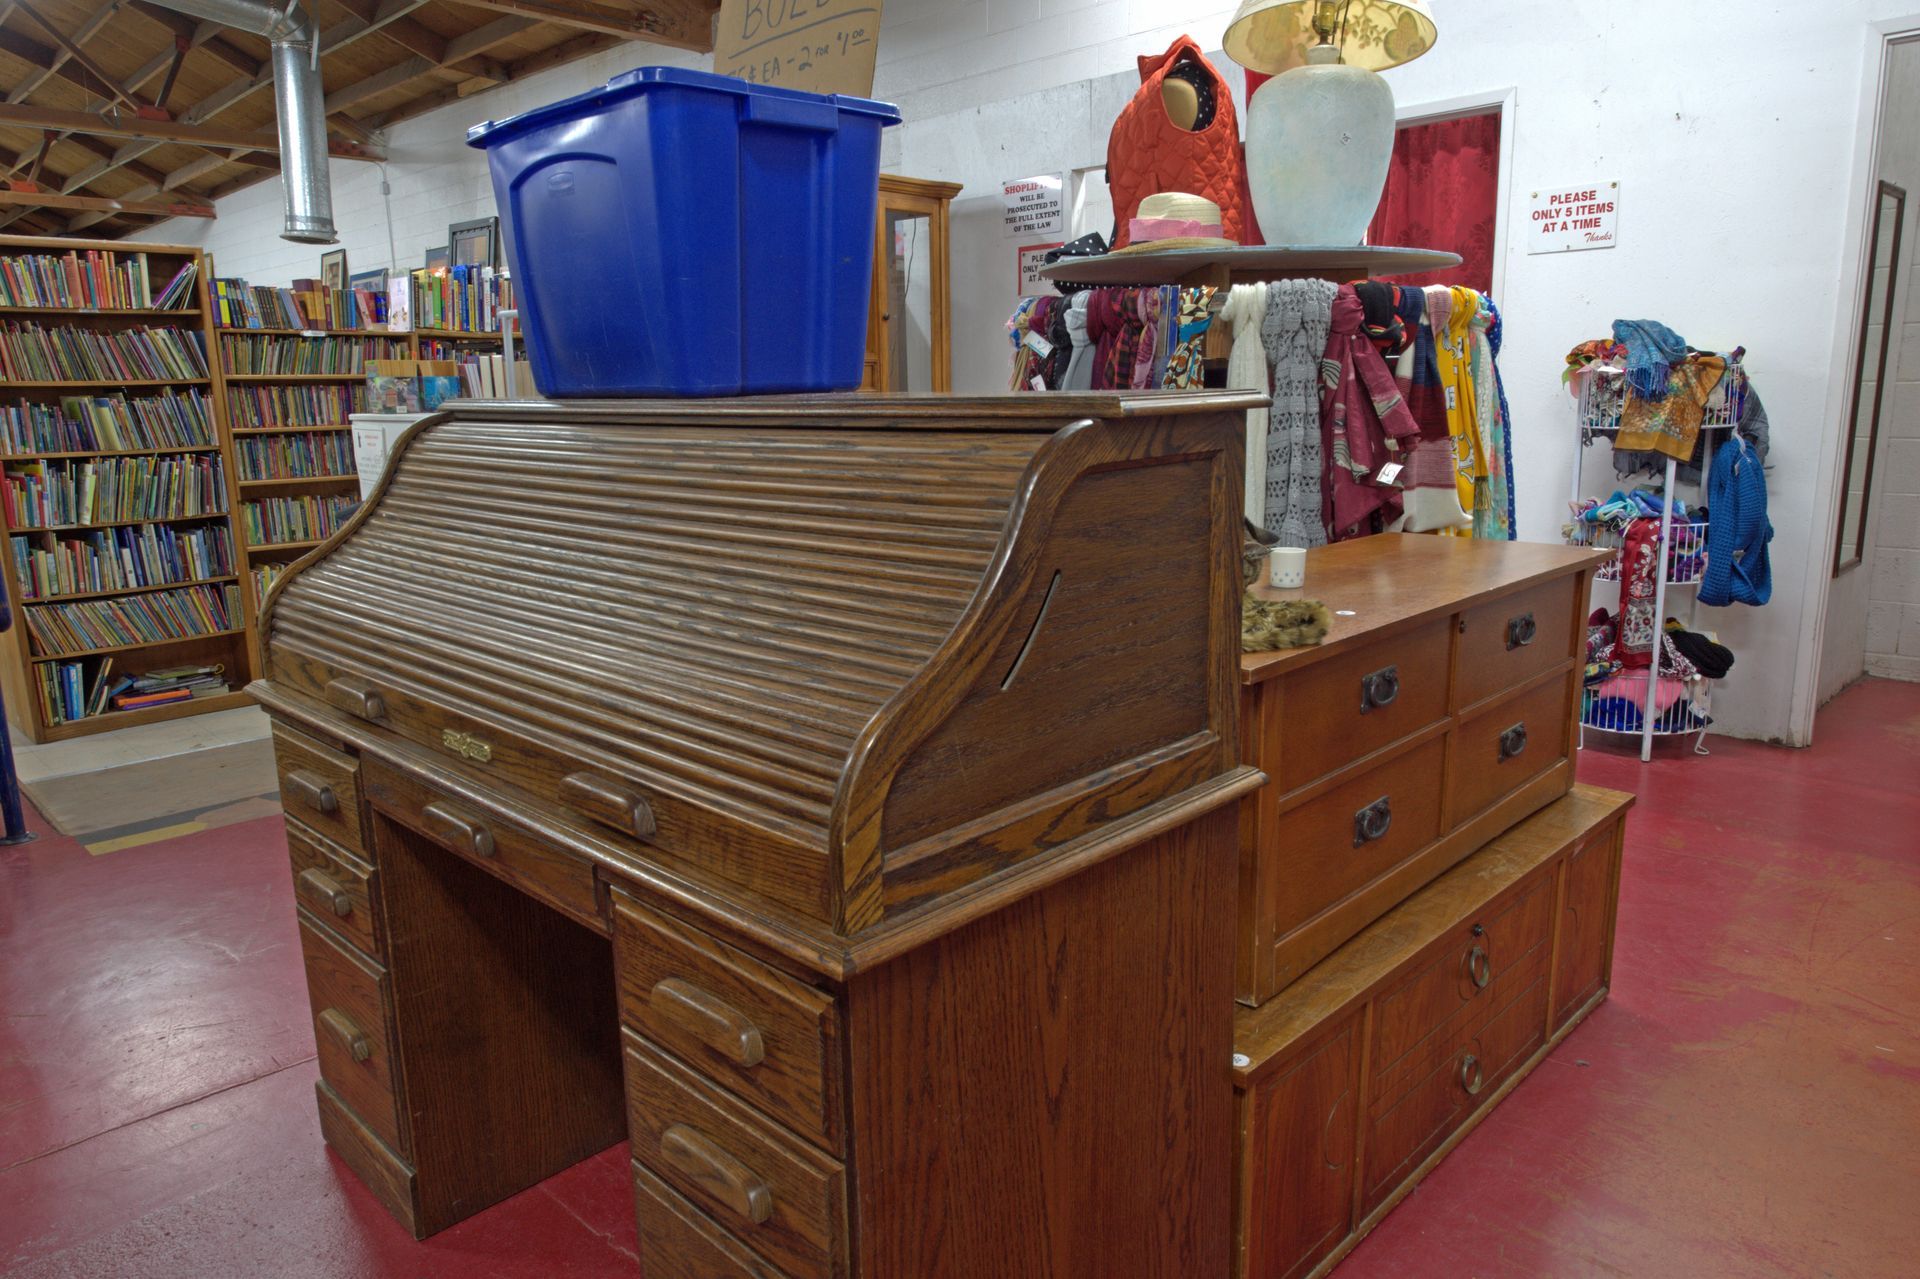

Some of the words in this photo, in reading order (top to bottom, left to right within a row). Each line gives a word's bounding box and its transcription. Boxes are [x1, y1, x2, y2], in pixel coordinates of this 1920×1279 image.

[763, 57, 781, 82] EA
[799, 46, 813, 71] 2
[815, 45, 829, 57] FOR
[1020, 194, 1035, 202] WILL
[1550, 190, 1597, 205] PLEASE
[1007, 202, 1048, 214] PROSECUTED
[1532, 208, 1562, 221] ONLY
[1565, 207, 1572, 217] 5
[1576, 202, 1614, 216] ITEMS
[1019, 214, 1034, 222] FULL
[1035, 210, 1060, 219] EXTENT
[1037, 221, 1051, 229] LAW
[1542, 222, 1557, 233] AT
[1560, 221, 1568, 231] A
[1572, 217, 1601, 230] TIME
[1584, 231, 1612, 243] Thanks
[1032, 254, 1044, 262] PLE
[1023, 265, 1038, 273] ONLY
